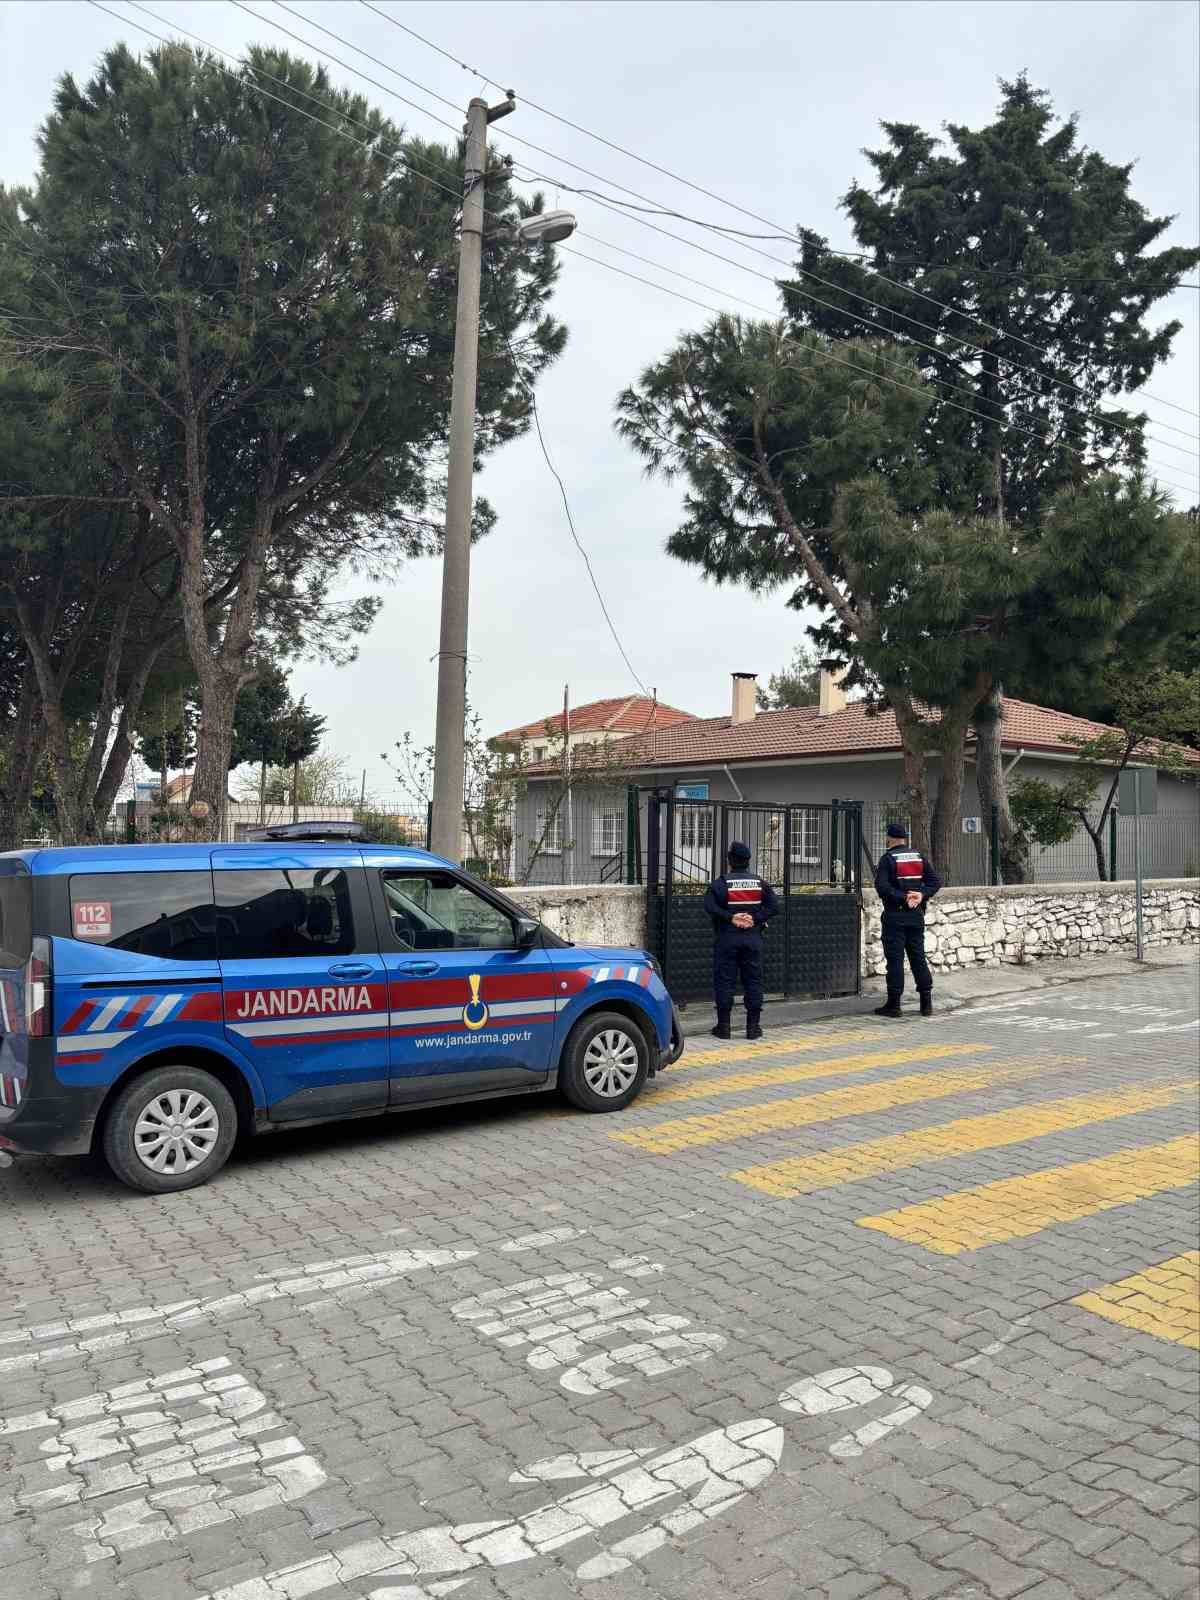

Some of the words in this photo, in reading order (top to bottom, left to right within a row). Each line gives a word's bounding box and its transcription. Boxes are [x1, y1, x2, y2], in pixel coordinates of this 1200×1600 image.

[80, 905, 106, 922] 112
[237, 986, 372, 1017] JANDARMA
[415, 1030, 533, 1049] www.jandarma.gov.tr
